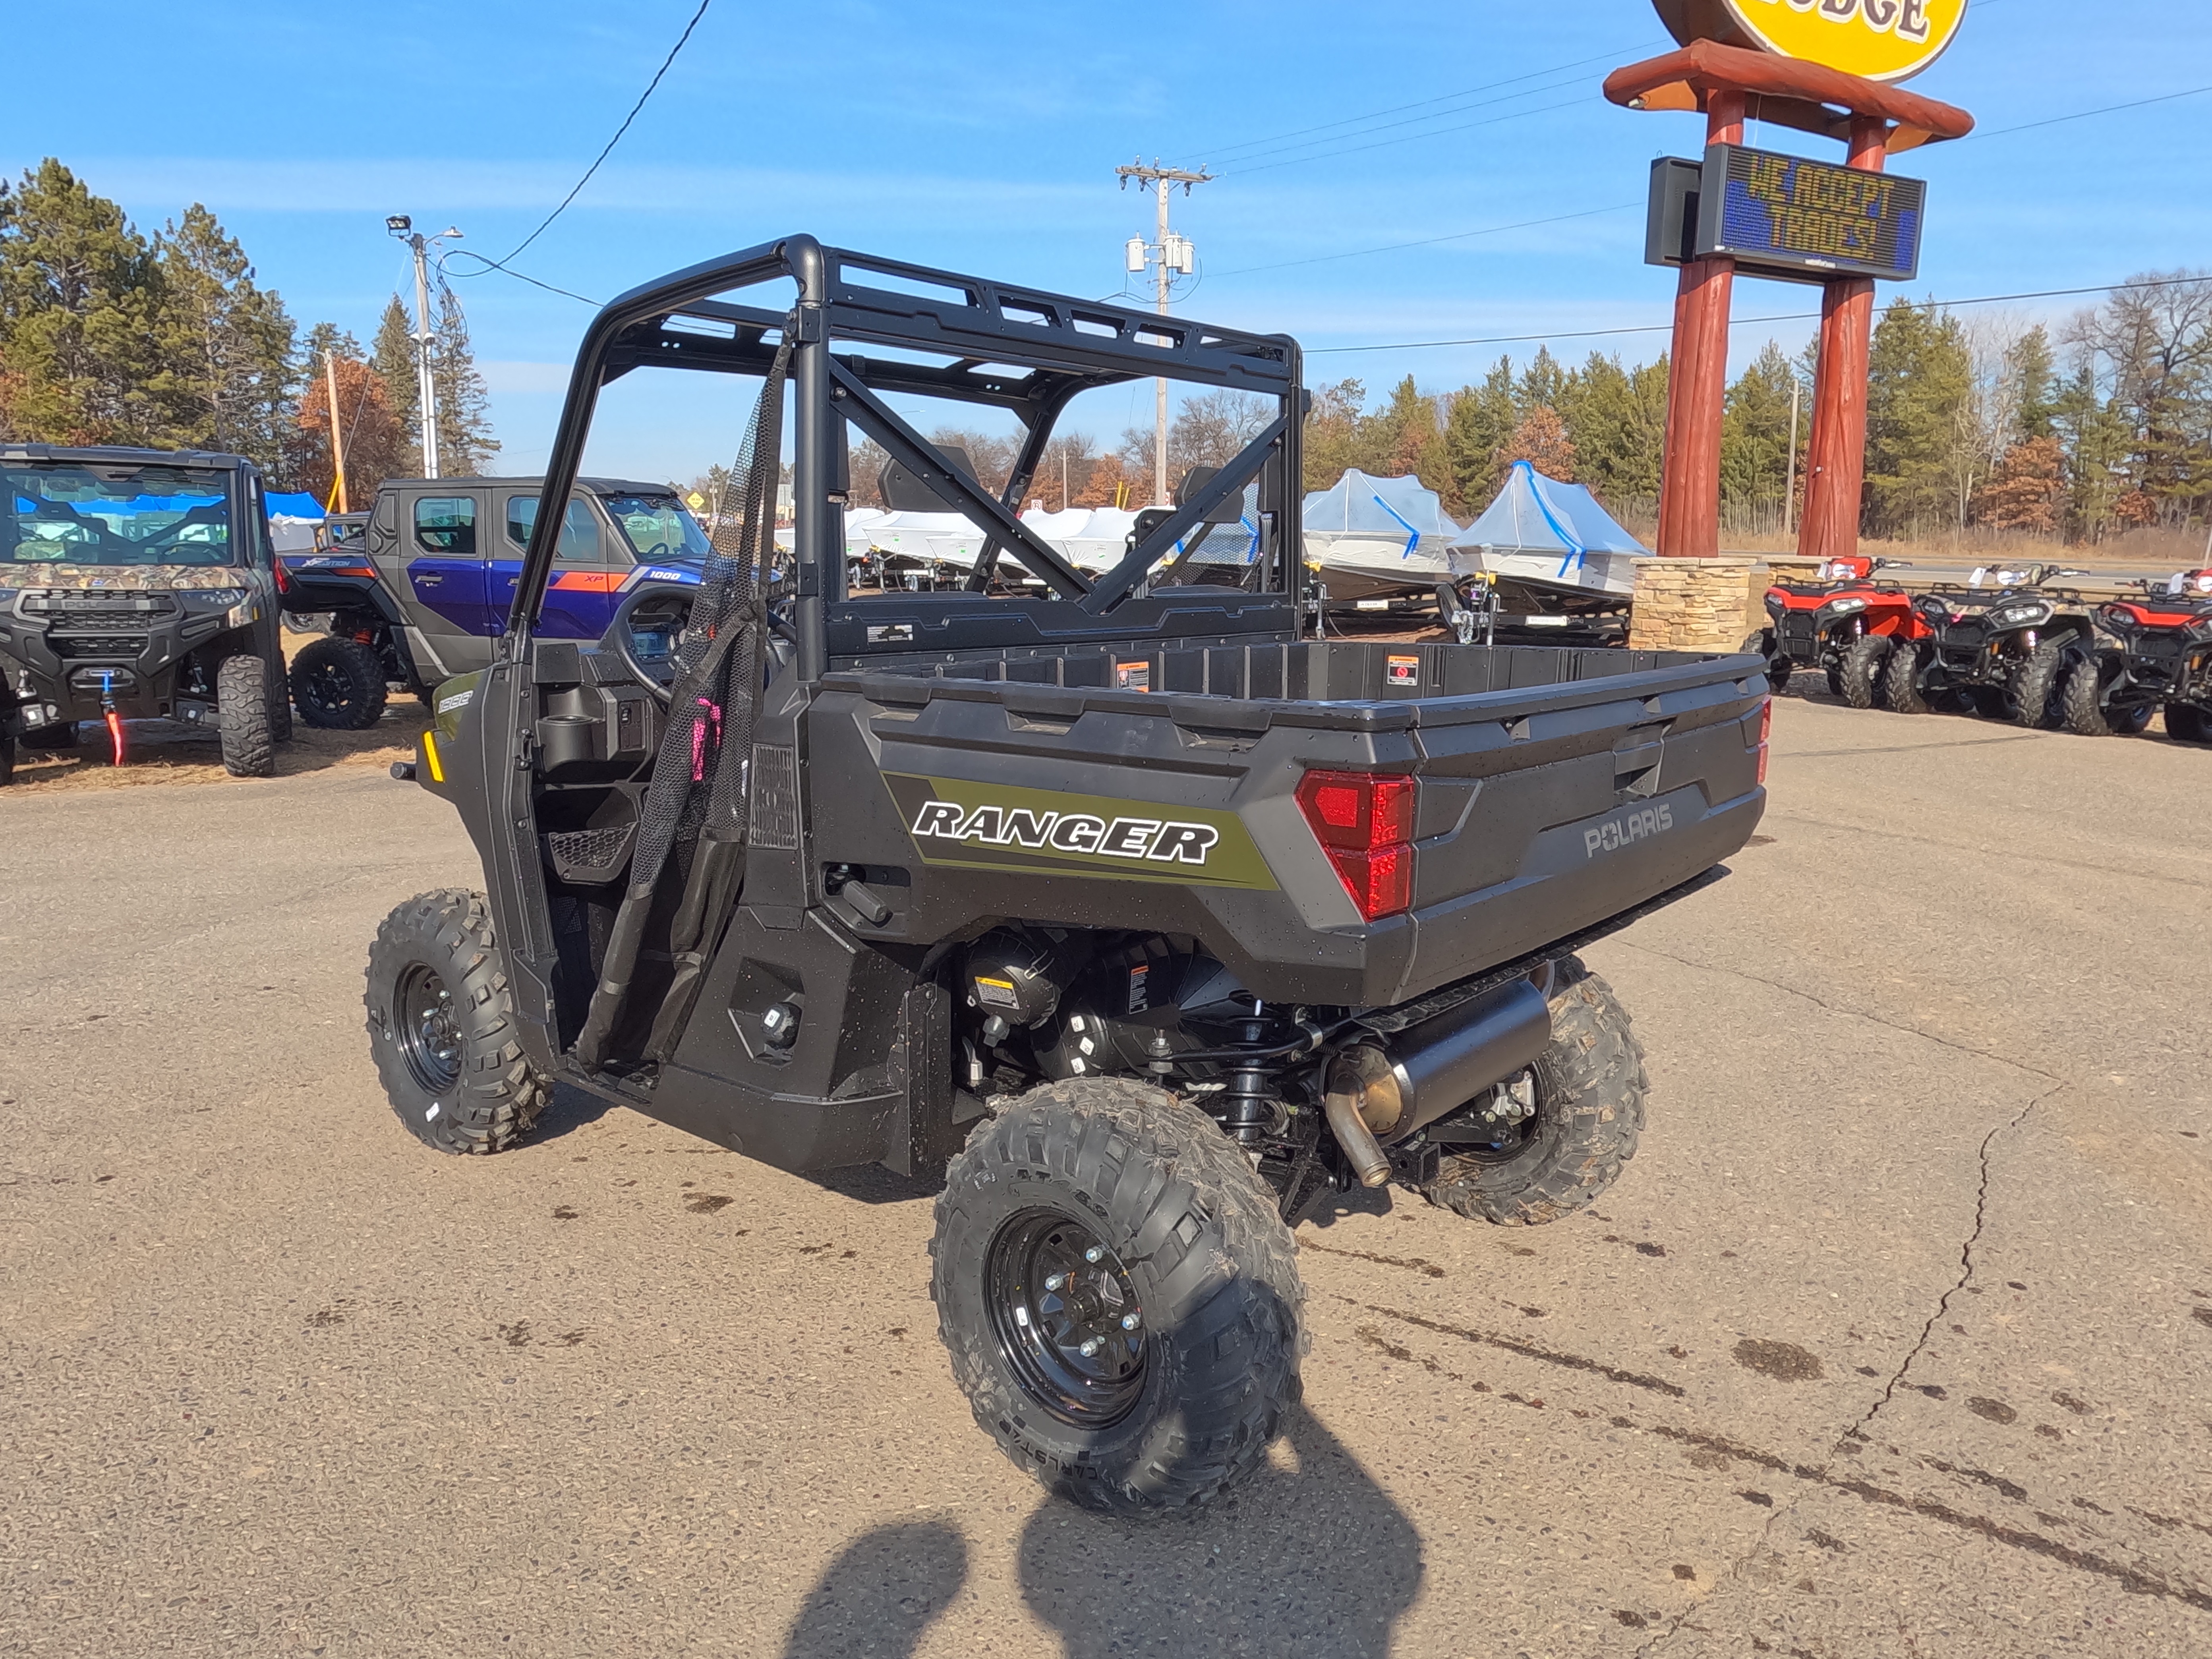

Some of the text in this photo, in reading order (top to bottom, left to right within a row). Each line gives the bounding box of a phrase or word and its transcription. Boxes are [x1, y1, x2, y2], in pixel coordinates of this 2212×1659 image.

[1749, 154, 1895, 219] WE ACCEPT
[1770, 204, 1878, 259] TRADES!
[649, 571, 681, 580] 1000
[912, 801, 1219, 864] RANGER
[1584, 803, 1673, 858] POLARIS
